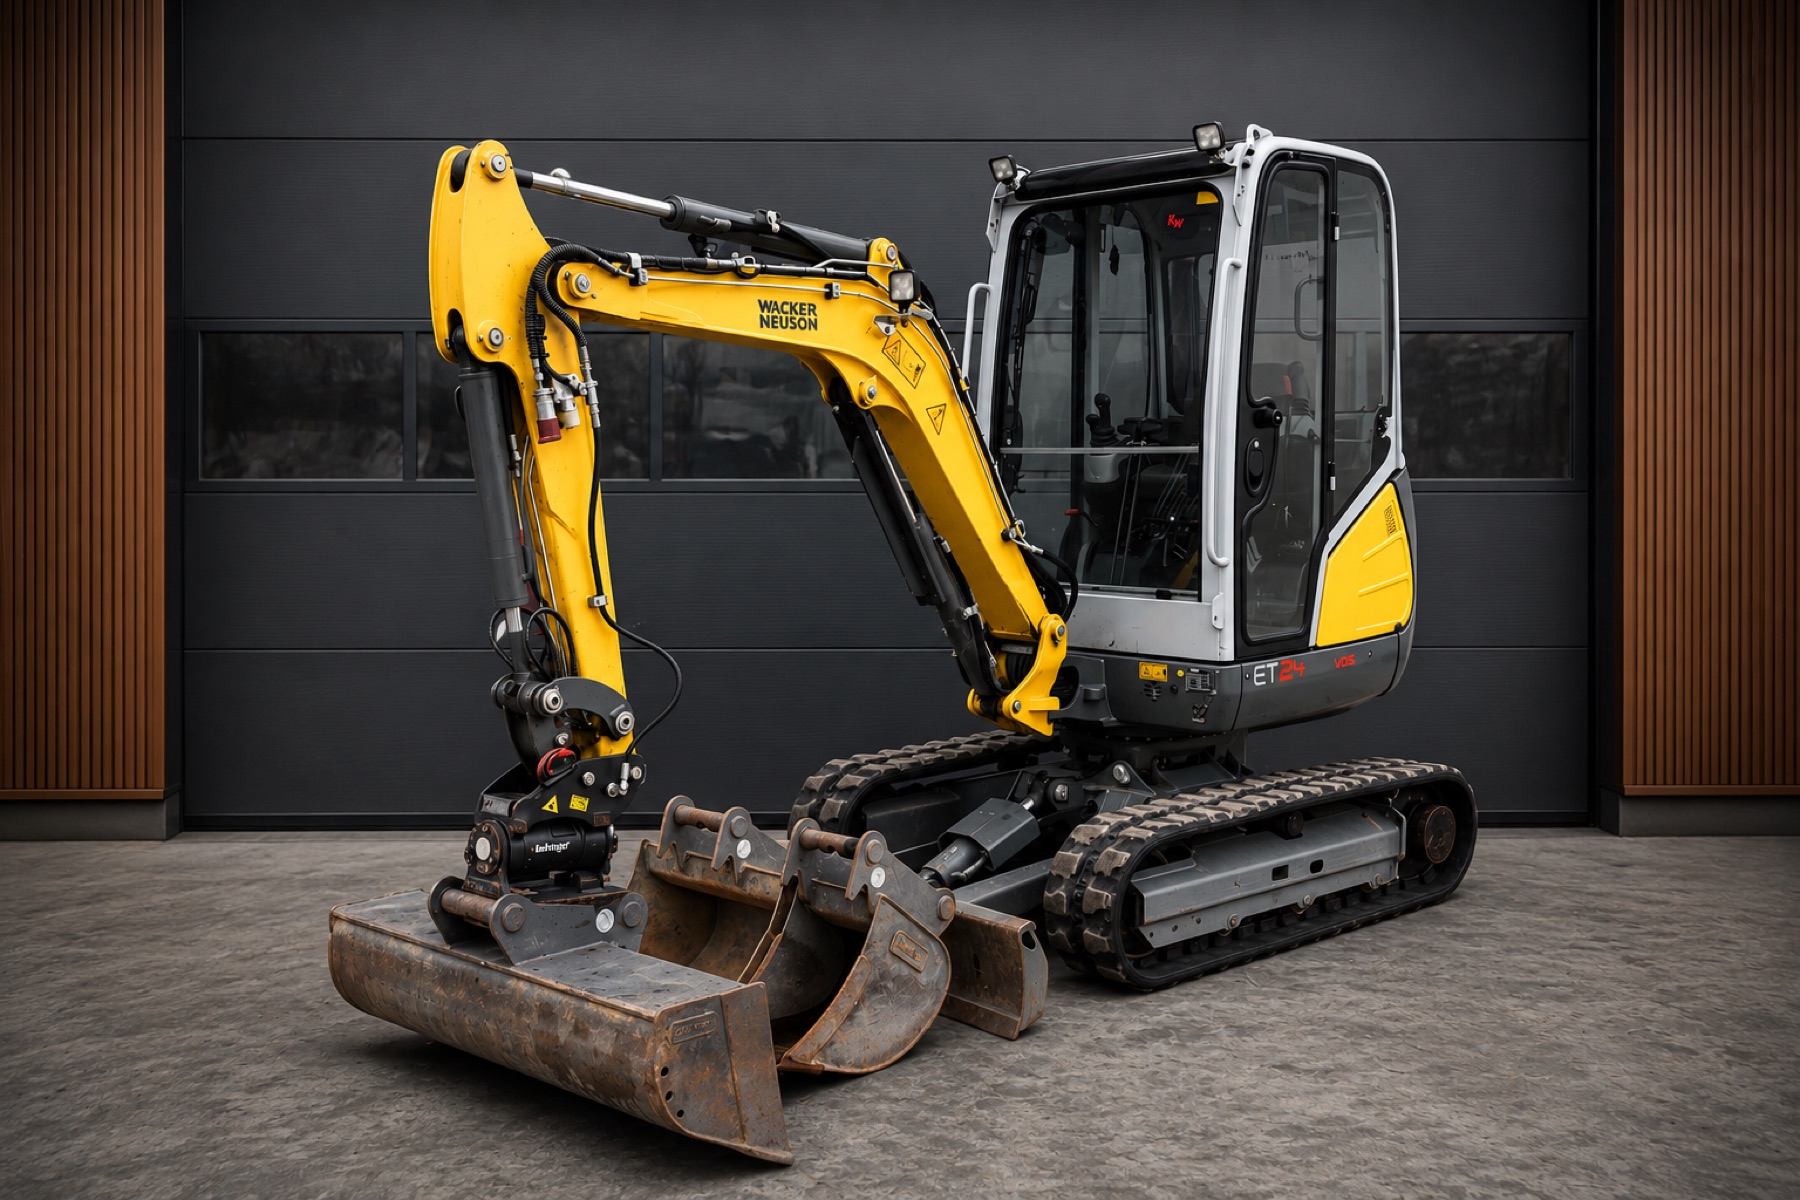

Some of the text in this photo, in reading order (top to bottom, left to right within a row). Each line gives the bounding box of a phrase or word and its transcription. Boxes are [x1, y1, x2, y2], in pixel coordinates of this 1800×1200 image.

[757, 299, 818, 317] WACKER
[759, 313, 818, 331] NEUSON
[1253, 654, 1355, 686] ET24 VDS
